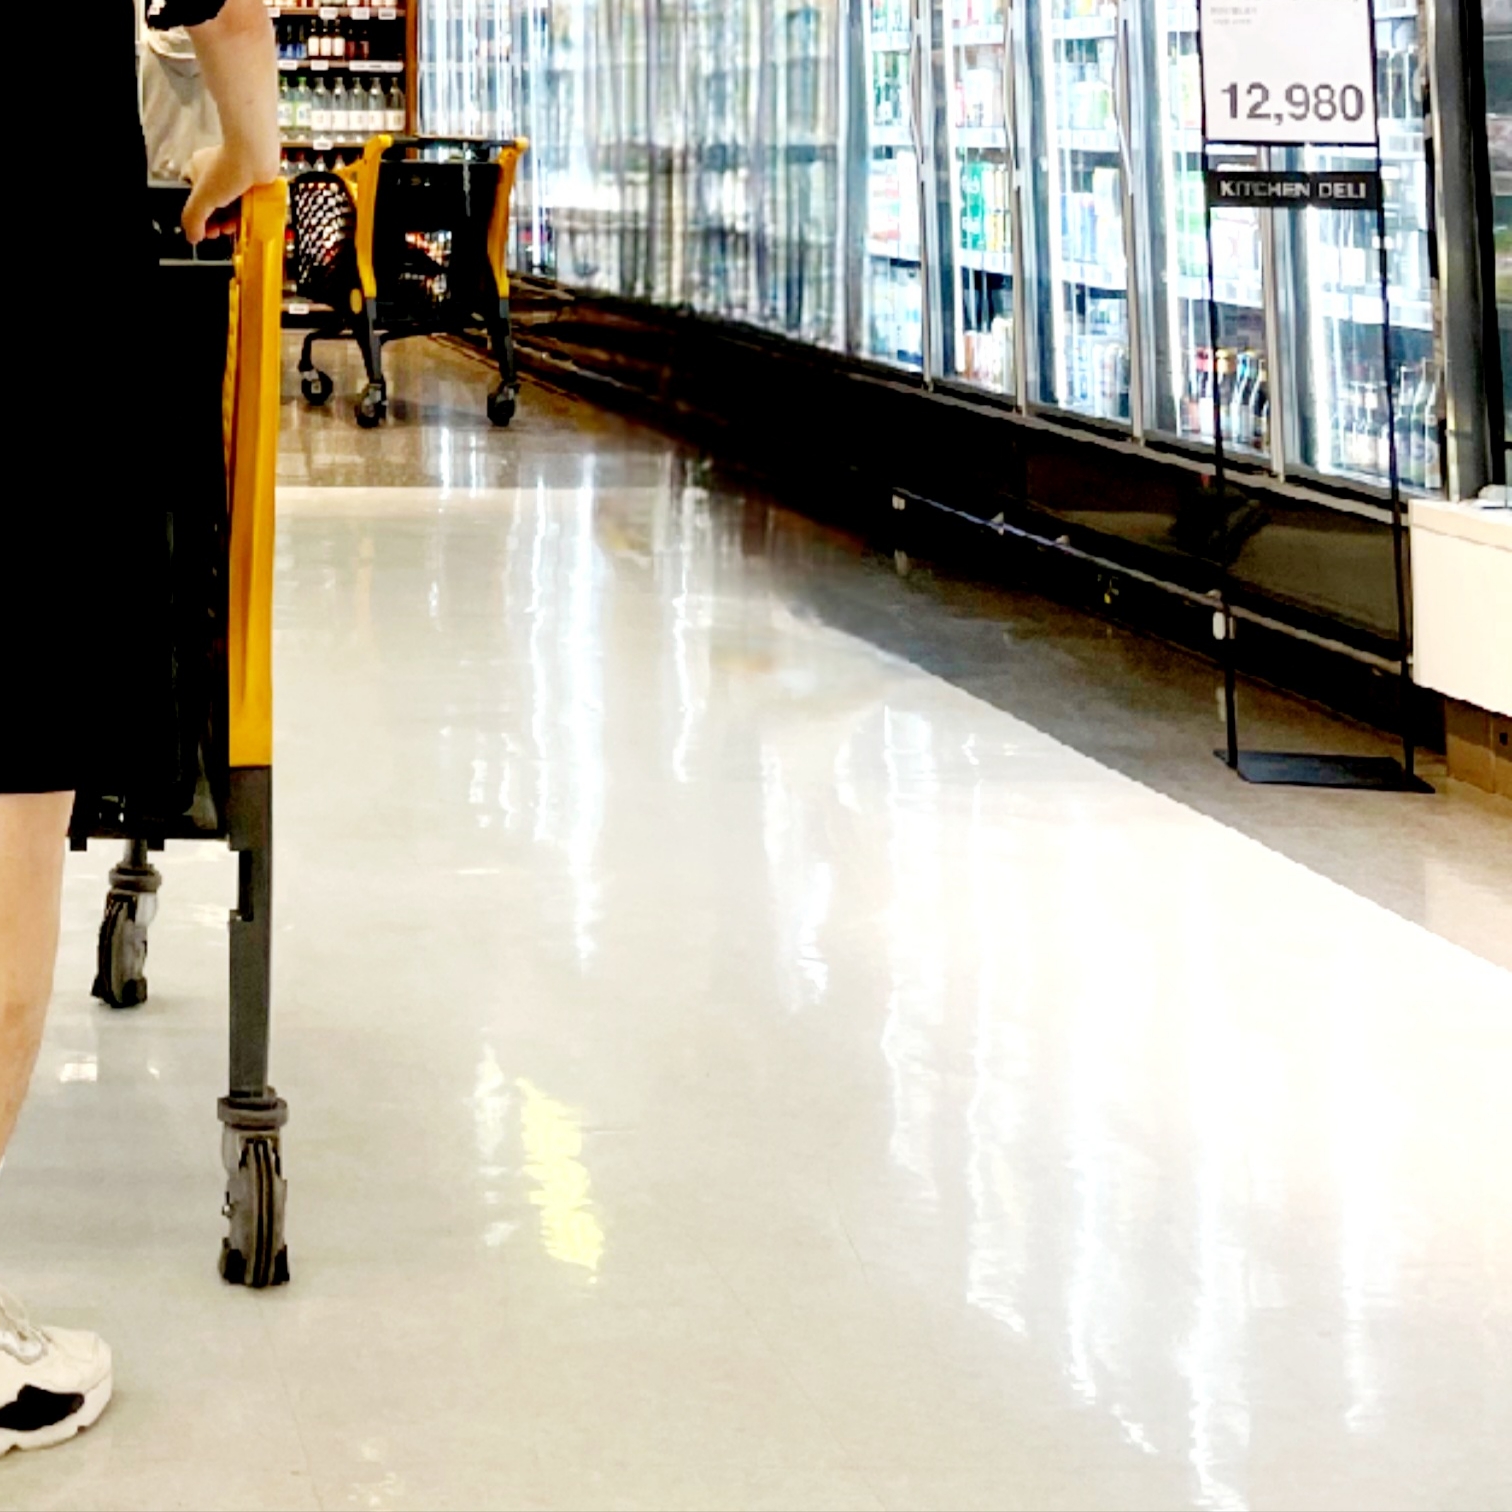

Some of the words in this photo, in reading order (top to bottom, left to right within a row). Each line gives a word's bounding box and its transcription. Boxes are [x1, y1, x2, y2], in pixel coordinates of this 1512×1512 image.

[1220, 82, 1364, 126] 12,980
[1220, 180, 1310, 198] KITCHEN
[1319, 182, 1366, 199] DELI
